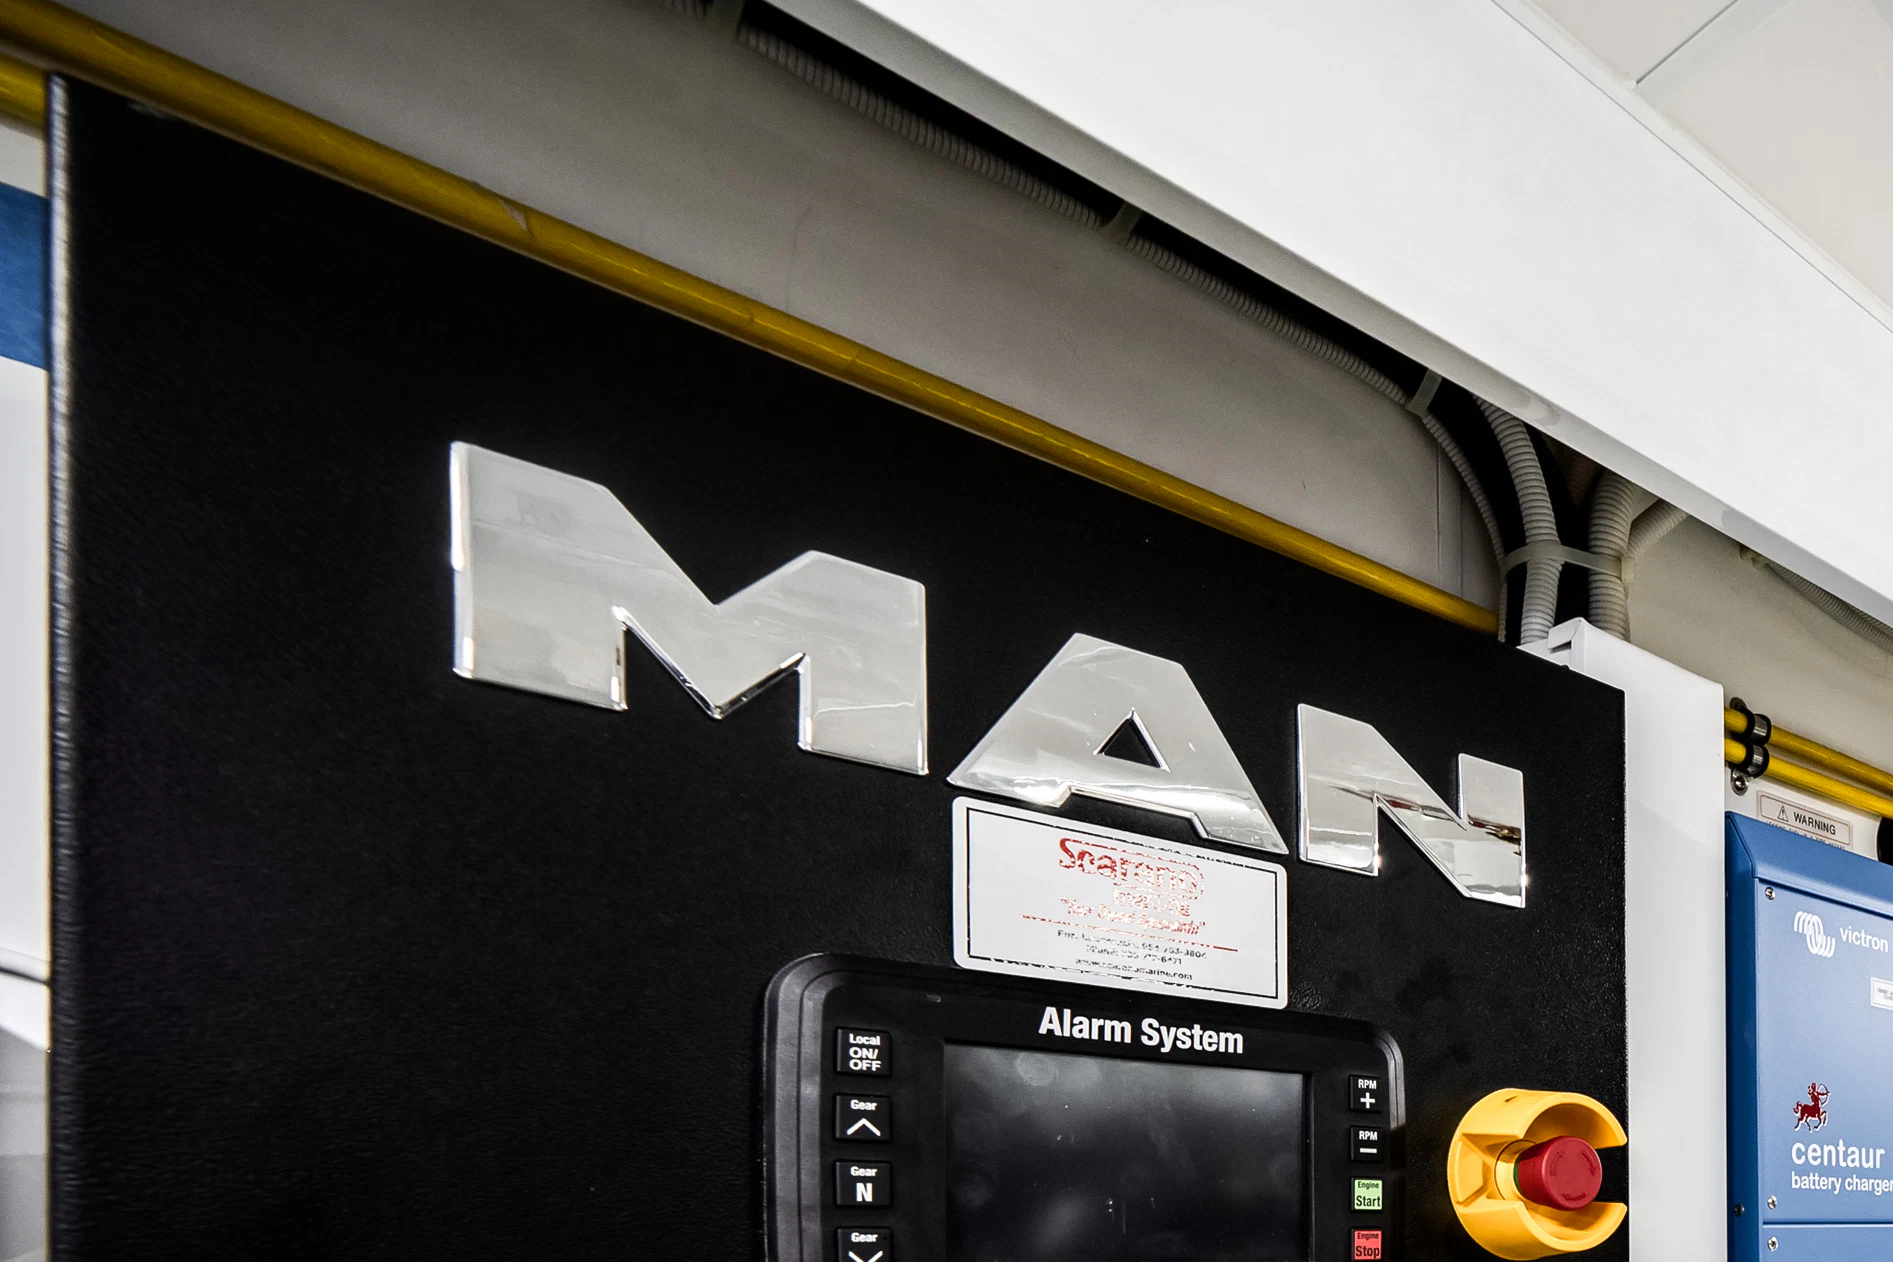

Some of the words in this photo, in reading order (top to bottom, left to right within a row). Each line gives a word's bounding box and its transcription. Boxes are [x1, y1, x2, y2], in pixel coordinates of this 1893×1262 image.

[450, 440, 1528, 908] MAN
[1793, 811, 1837, 836] WARNING
[1839, 925, 1889, 953] victron
[1038, 1006, 1133, 1044] Alarm
[1140, 1018, 1244, 1056] System
[849, 1033, 882, 1046] Local
[849, 1046, 879, 1060] ON/
[849, 1059, 882, 1072] OFF
[1358, 1079, 1377, 1090] RPM
[850, 1099, 878, 1111] Gear
[1359, 1130, 1378, 1141] RPM
[1791, 1138, 1886, 1169] centaur
[850, 1166, 878, 1177] Gear
[1357, 1181, 1380, 1190] Engine
[1791, 1170, 1842, 1195] battery
[856, 1182, 873, 1202] N
[1356, 1195, 1381, 1207] Start
[851, 1232, 878, 1243] Gear
[1357, 1232, 1379, 1240] Engine
[1355, 1245, 1380, 1259] Stop
